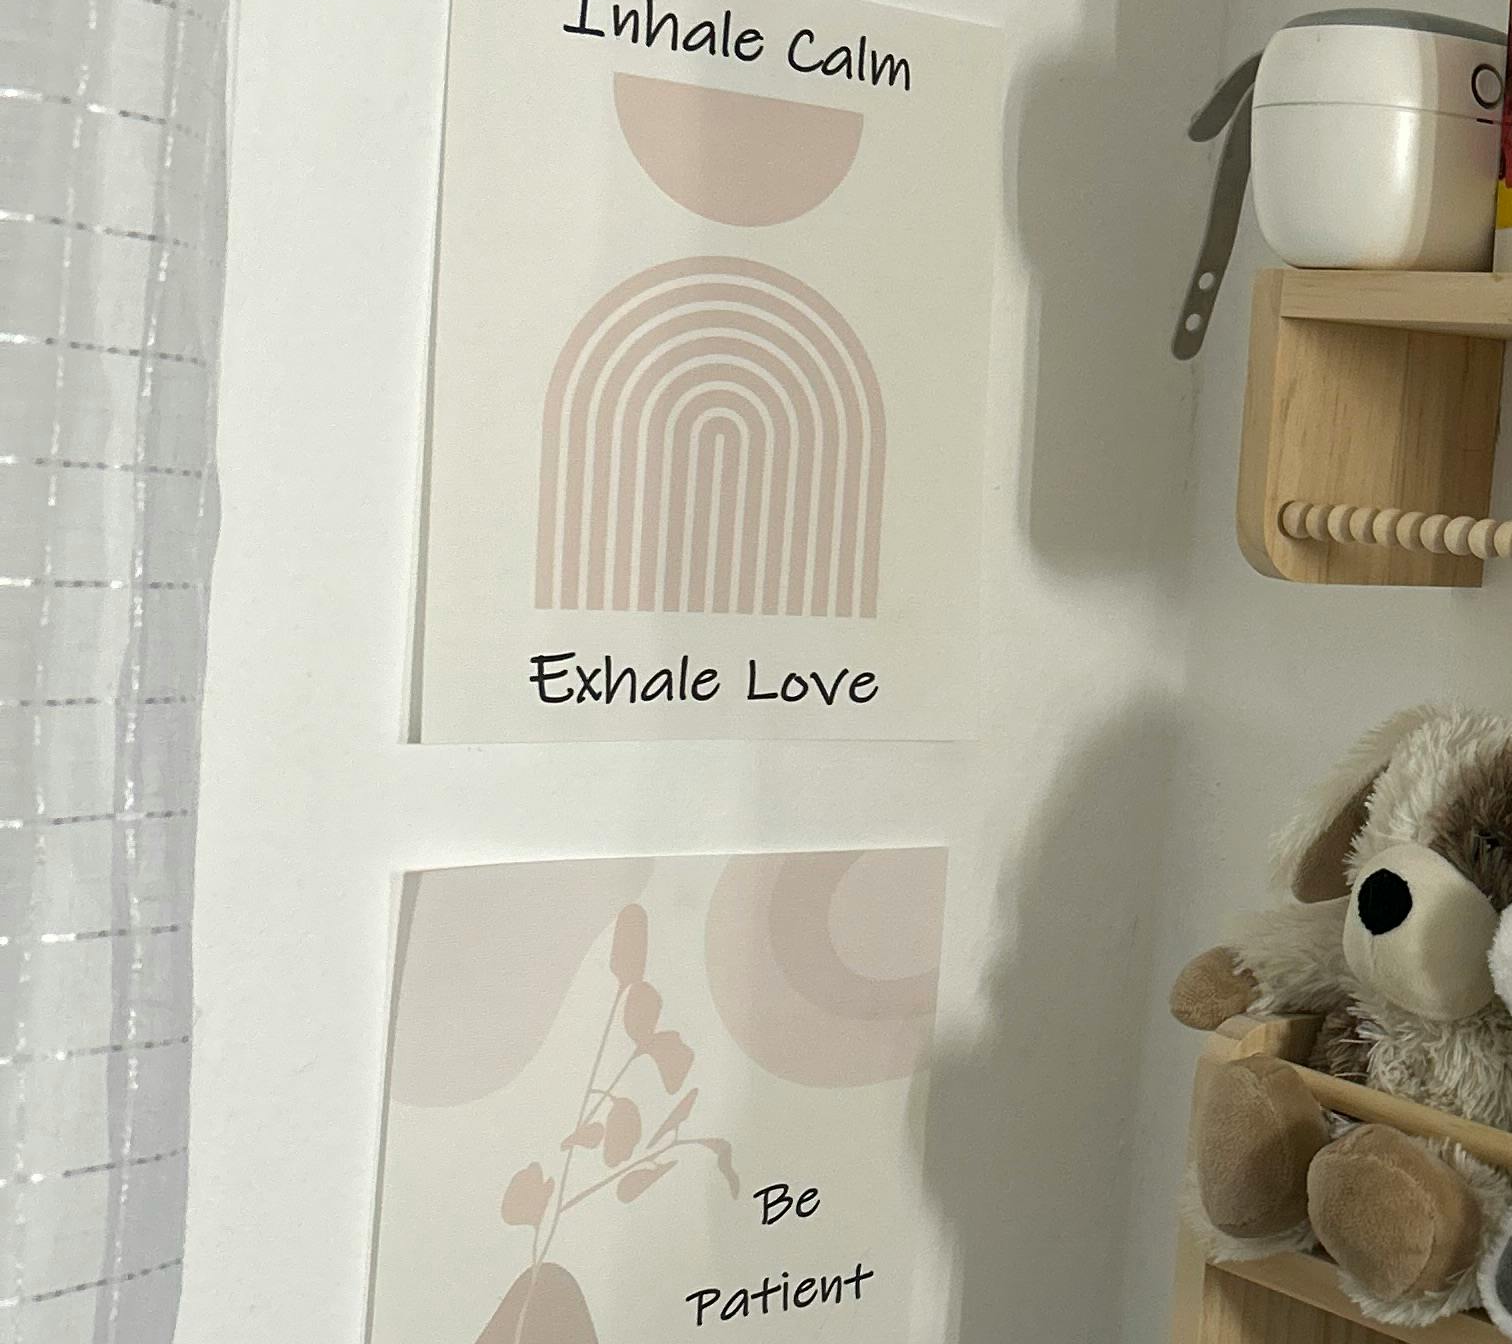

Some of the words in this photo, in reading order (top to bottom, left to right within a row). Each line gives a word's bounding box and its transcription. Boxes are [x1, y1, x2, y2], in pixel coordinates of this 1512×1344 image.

[787, 29, 911, 91] Calm
[530, 652, 720, 705] Exhale
[747, 659, 879, 706] Love
[753, 1183, 820, 1225] Be
[686, 1263, 874, 1327] Patient
